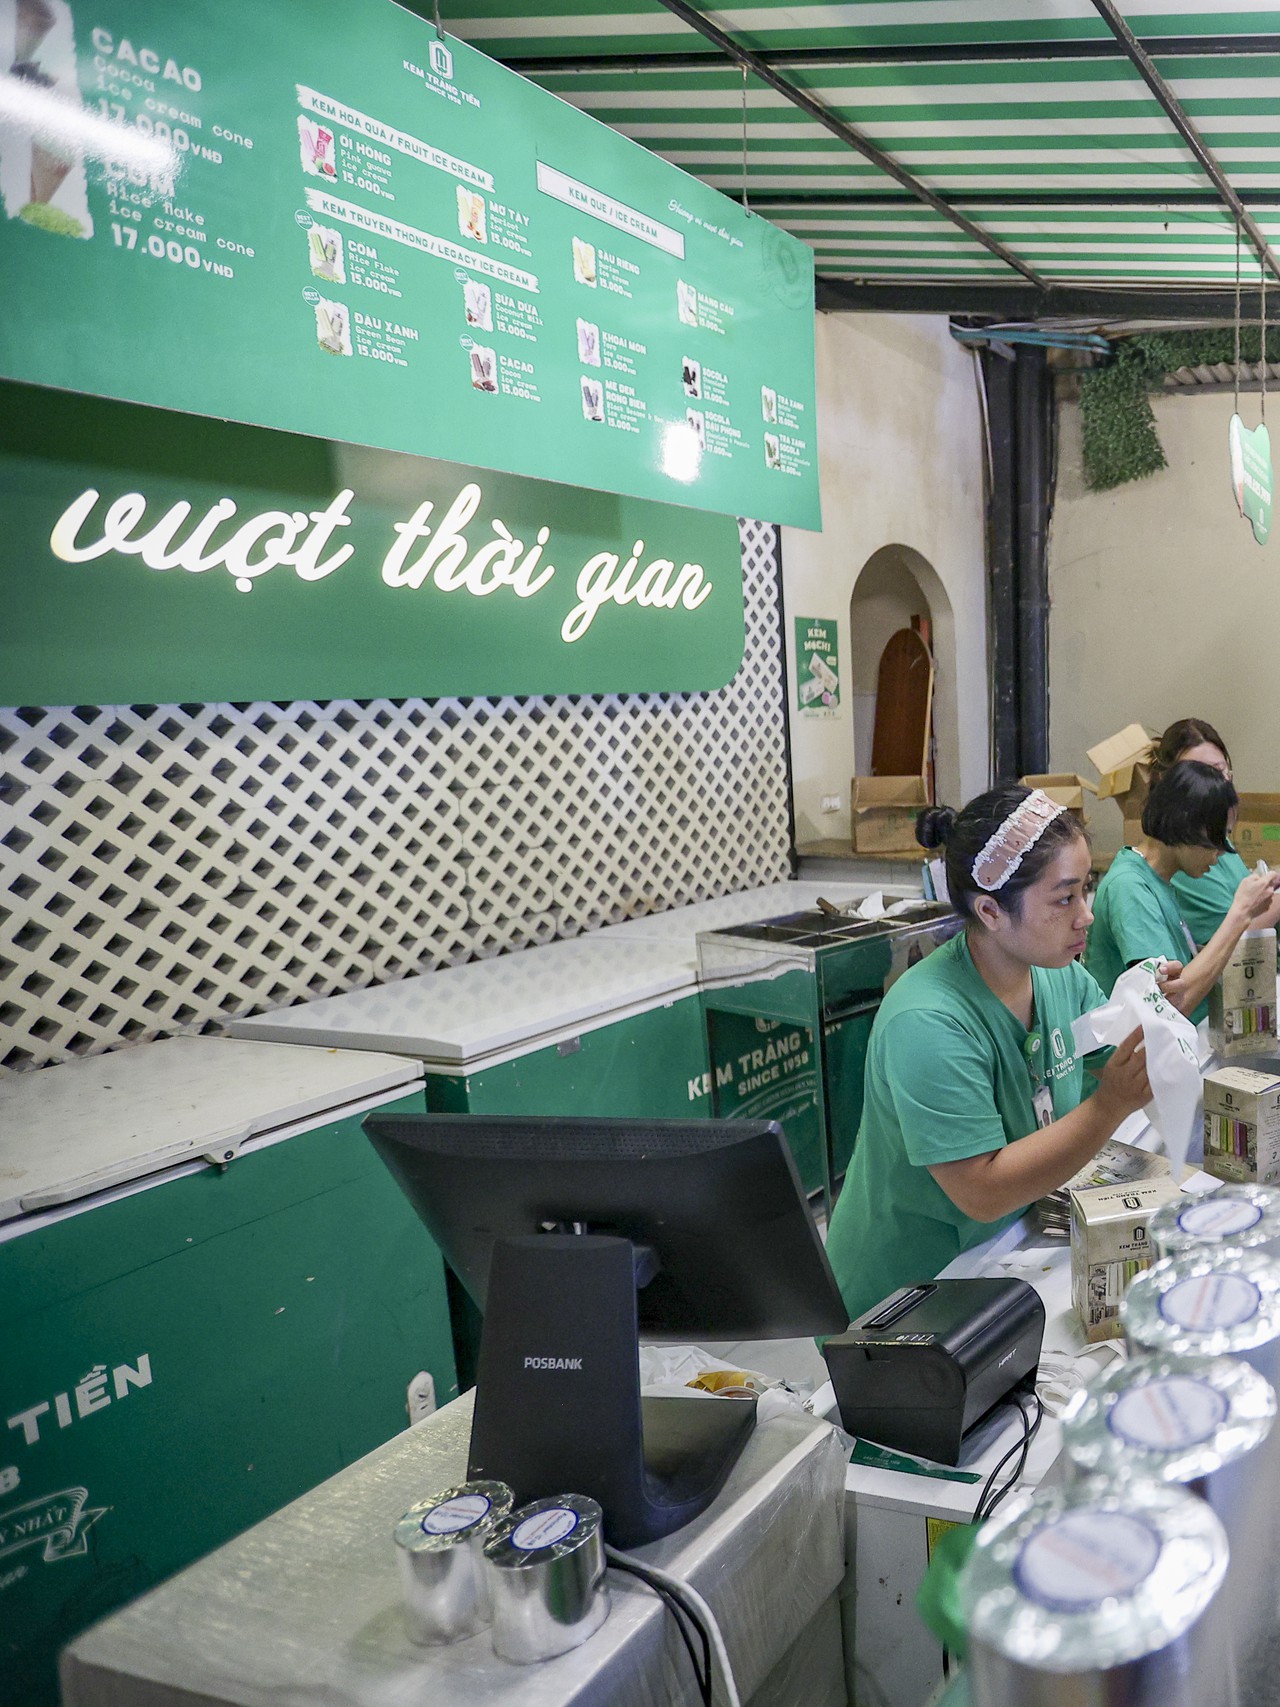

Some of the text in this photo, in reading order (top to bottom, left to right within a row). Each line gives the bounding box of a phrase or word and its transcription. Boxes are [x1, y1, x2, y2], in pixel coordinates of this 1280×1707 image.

[92, 27, 202, 92] CACAO
[94, 55, 155, 92] Cocoa
[403, 60, 425, 79] KEM
[97, 74, 254, 149] ice cream cone
[311, 97, 336, 116] KEM
[339, 110, 361, 128] HOA
[397, 137, 428, 158] FRUIT
[431, 153, 448, 167] ICE
[450, 162, 486, 184] CREAM
[340, 149, 362, 164] Pink
[341, 159, 358, 171] ice
[106, 181, 151, 208] Rice
[568, 187, 588, 204] KEM
[615, 211, 628, 223] ICE
[630, 218, 657, 238] CREAM
[109, 199, 255, 257] ice cream cone
[322, 200, 347, 217] KEM
[438, 245, 477, 267] LEGACY
[480, 260, 495, 273] ICE
[497, 268, 529, 286] CREAM
[385, 321, 419, 341] XANH
[500, 355, 534, 374] CACAO
[50, 482, 713, 644] vượt thời gian
[808, 629, 827, 640] KEM
[738, 1068, 780, 1096] SINCE
[524, 1357, 583, 1370] POSBANK
